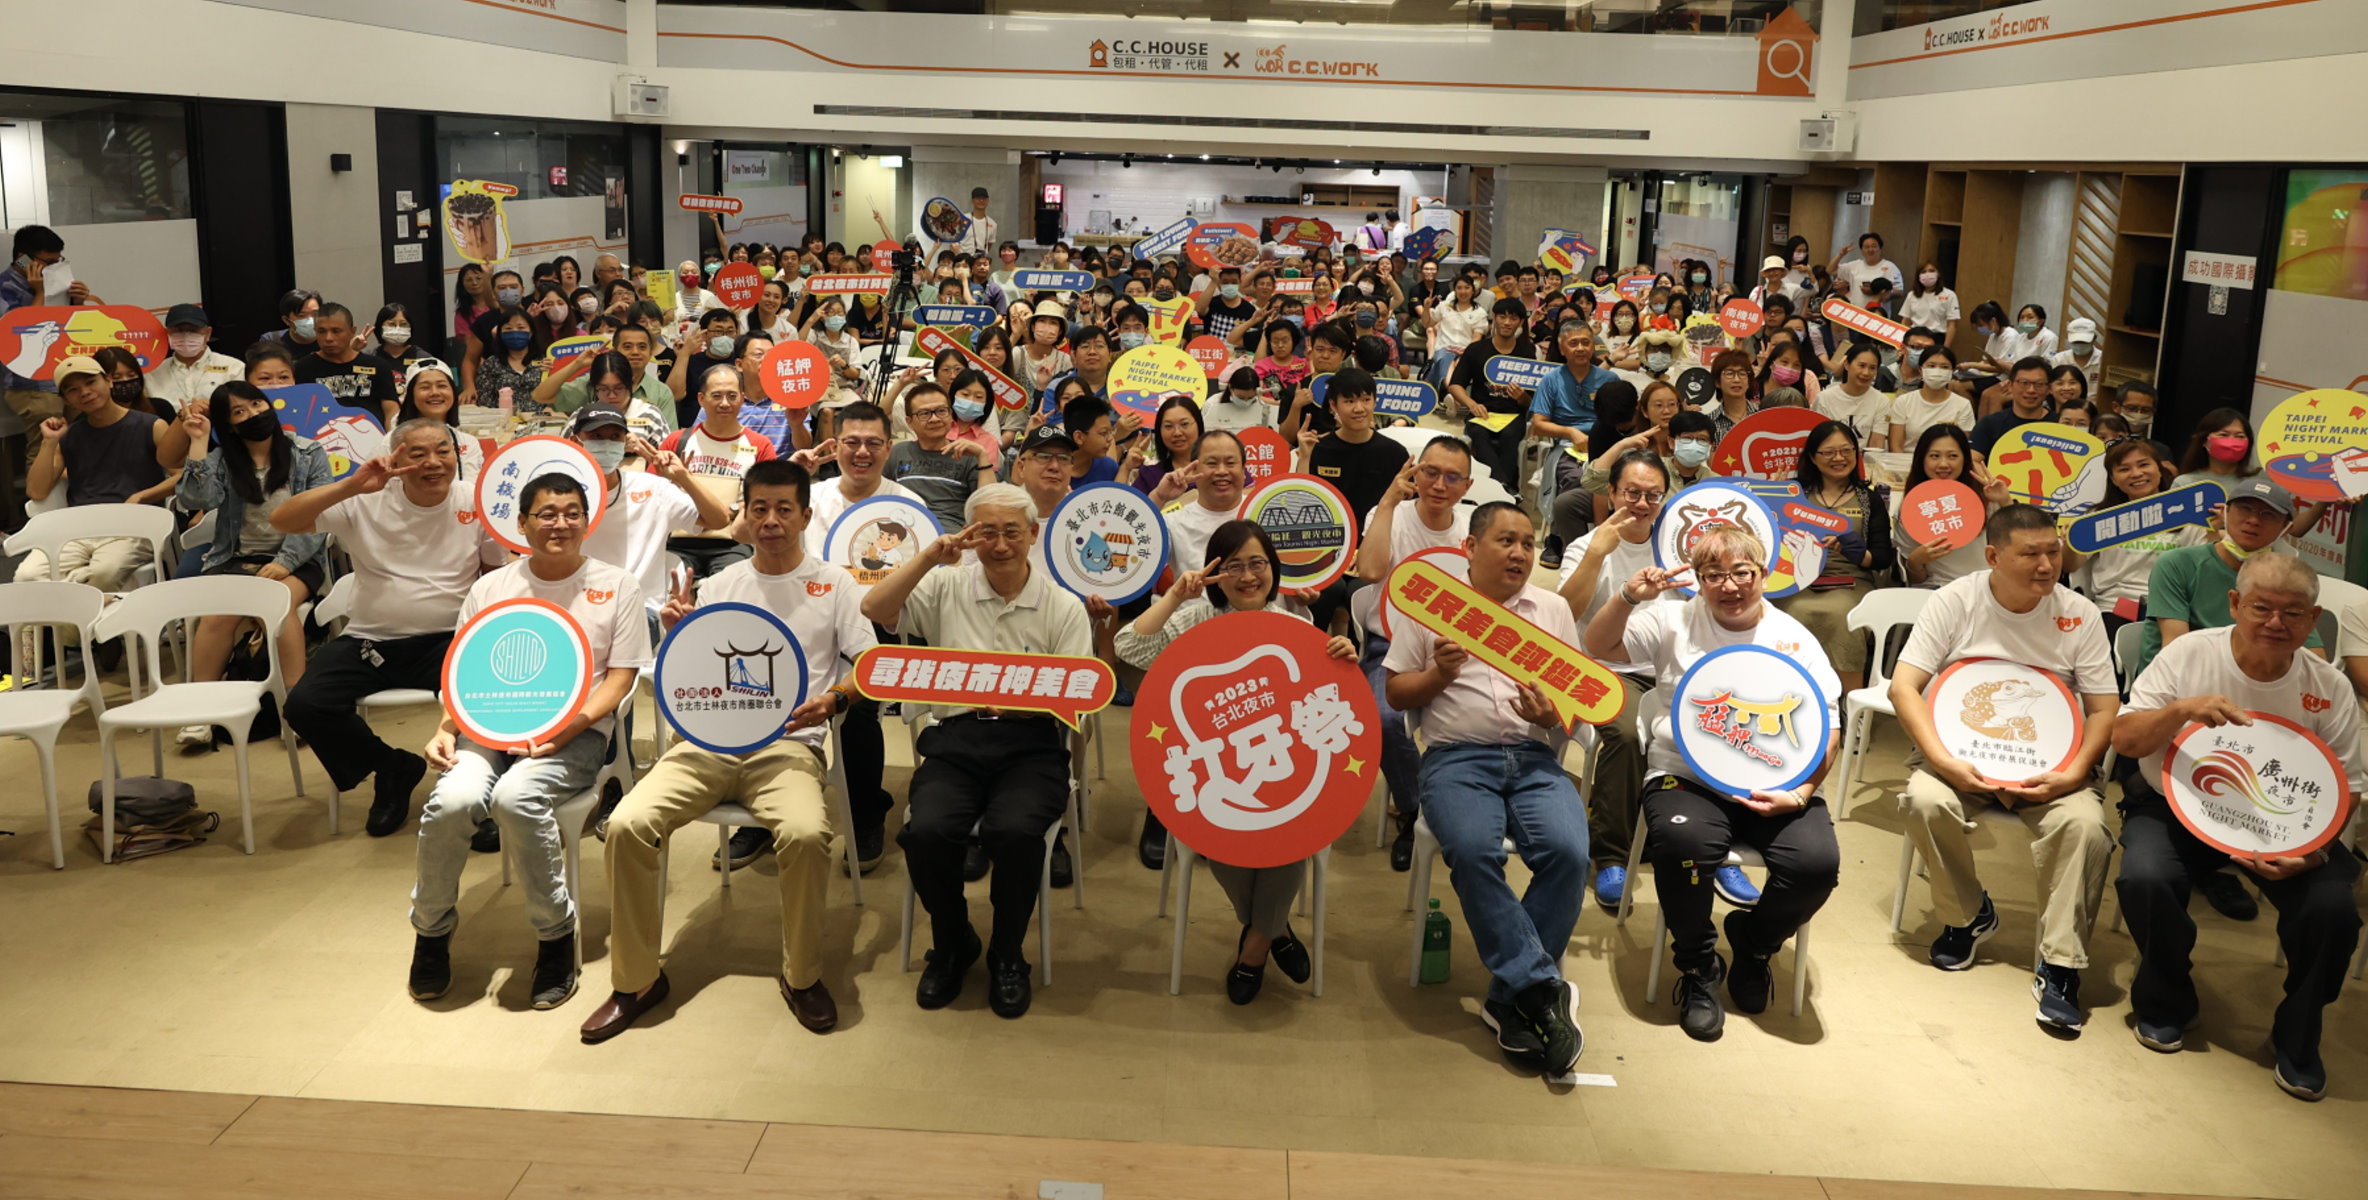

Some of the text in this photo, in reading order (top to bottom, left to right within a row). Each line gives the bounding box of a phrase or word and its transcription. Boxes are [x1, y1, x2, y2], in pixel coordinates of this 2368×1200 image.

[1932, 29, 1975, 47] C.C.HOUSE
[1112, 39, 1208, 56] C.C.HOUSE
[1288, 60, 1379, 76] C.C.WORK
[875, 249, 893, 258] 廣州
[720, 275, 758, 290] 梧州街
[730, 290, 752, 301] 夜市
[776, 357, 812, 377] 艋舺
[1130, 359, 1160, 369] TAIPEI
[1497, 359, 1530, 373] KEEP
[1126, 375, 1168, 387] FESTIVAL
[1128, 367, 1198, 384] NIGHT MARKET
[781, 378, 811, 394] 夜市
[1375, 385, 1422, 398] OVING
[1381, 398, 1422, 412] FOOD
[2286, 414, 2327, 423] TAIPEI
[2284, 424, 2326, 433] NIGHT
[2283, 434, 2344, 445] FESTIVAL
[1244, 444, 1275, 460] 公館
[1769, 447, 1797, 457] 2023
[490, 460, 520, 520] 南機場
[1918, 494, 1962, 519] 寧夏
[1792, 507, 1839, 527] Yummy!
[1928, 515, 1964, 535] 夜市
[1399, 573, 1611, 709] 平民美食評鑑家
[869, 657, 1100, 699] 尋找夜市神美食
[731, 685, 769, 698] SHILIN
[1215, 679, 1258, 707] 2023
[1211, 691, 1276, 730] 台北夜市
[1163, 683, 1364, 812] 打牙祭
[2212, 736, 2255, 755] 臺北市
[2257, 758, 2322, 799] 廣州街
[2266, 785, 2296, 806] 夜市
[2200, 808, 2290, 842] NIGHT MARKET
[2201, 800, 2291, 834] GUANGZHOU ST.
